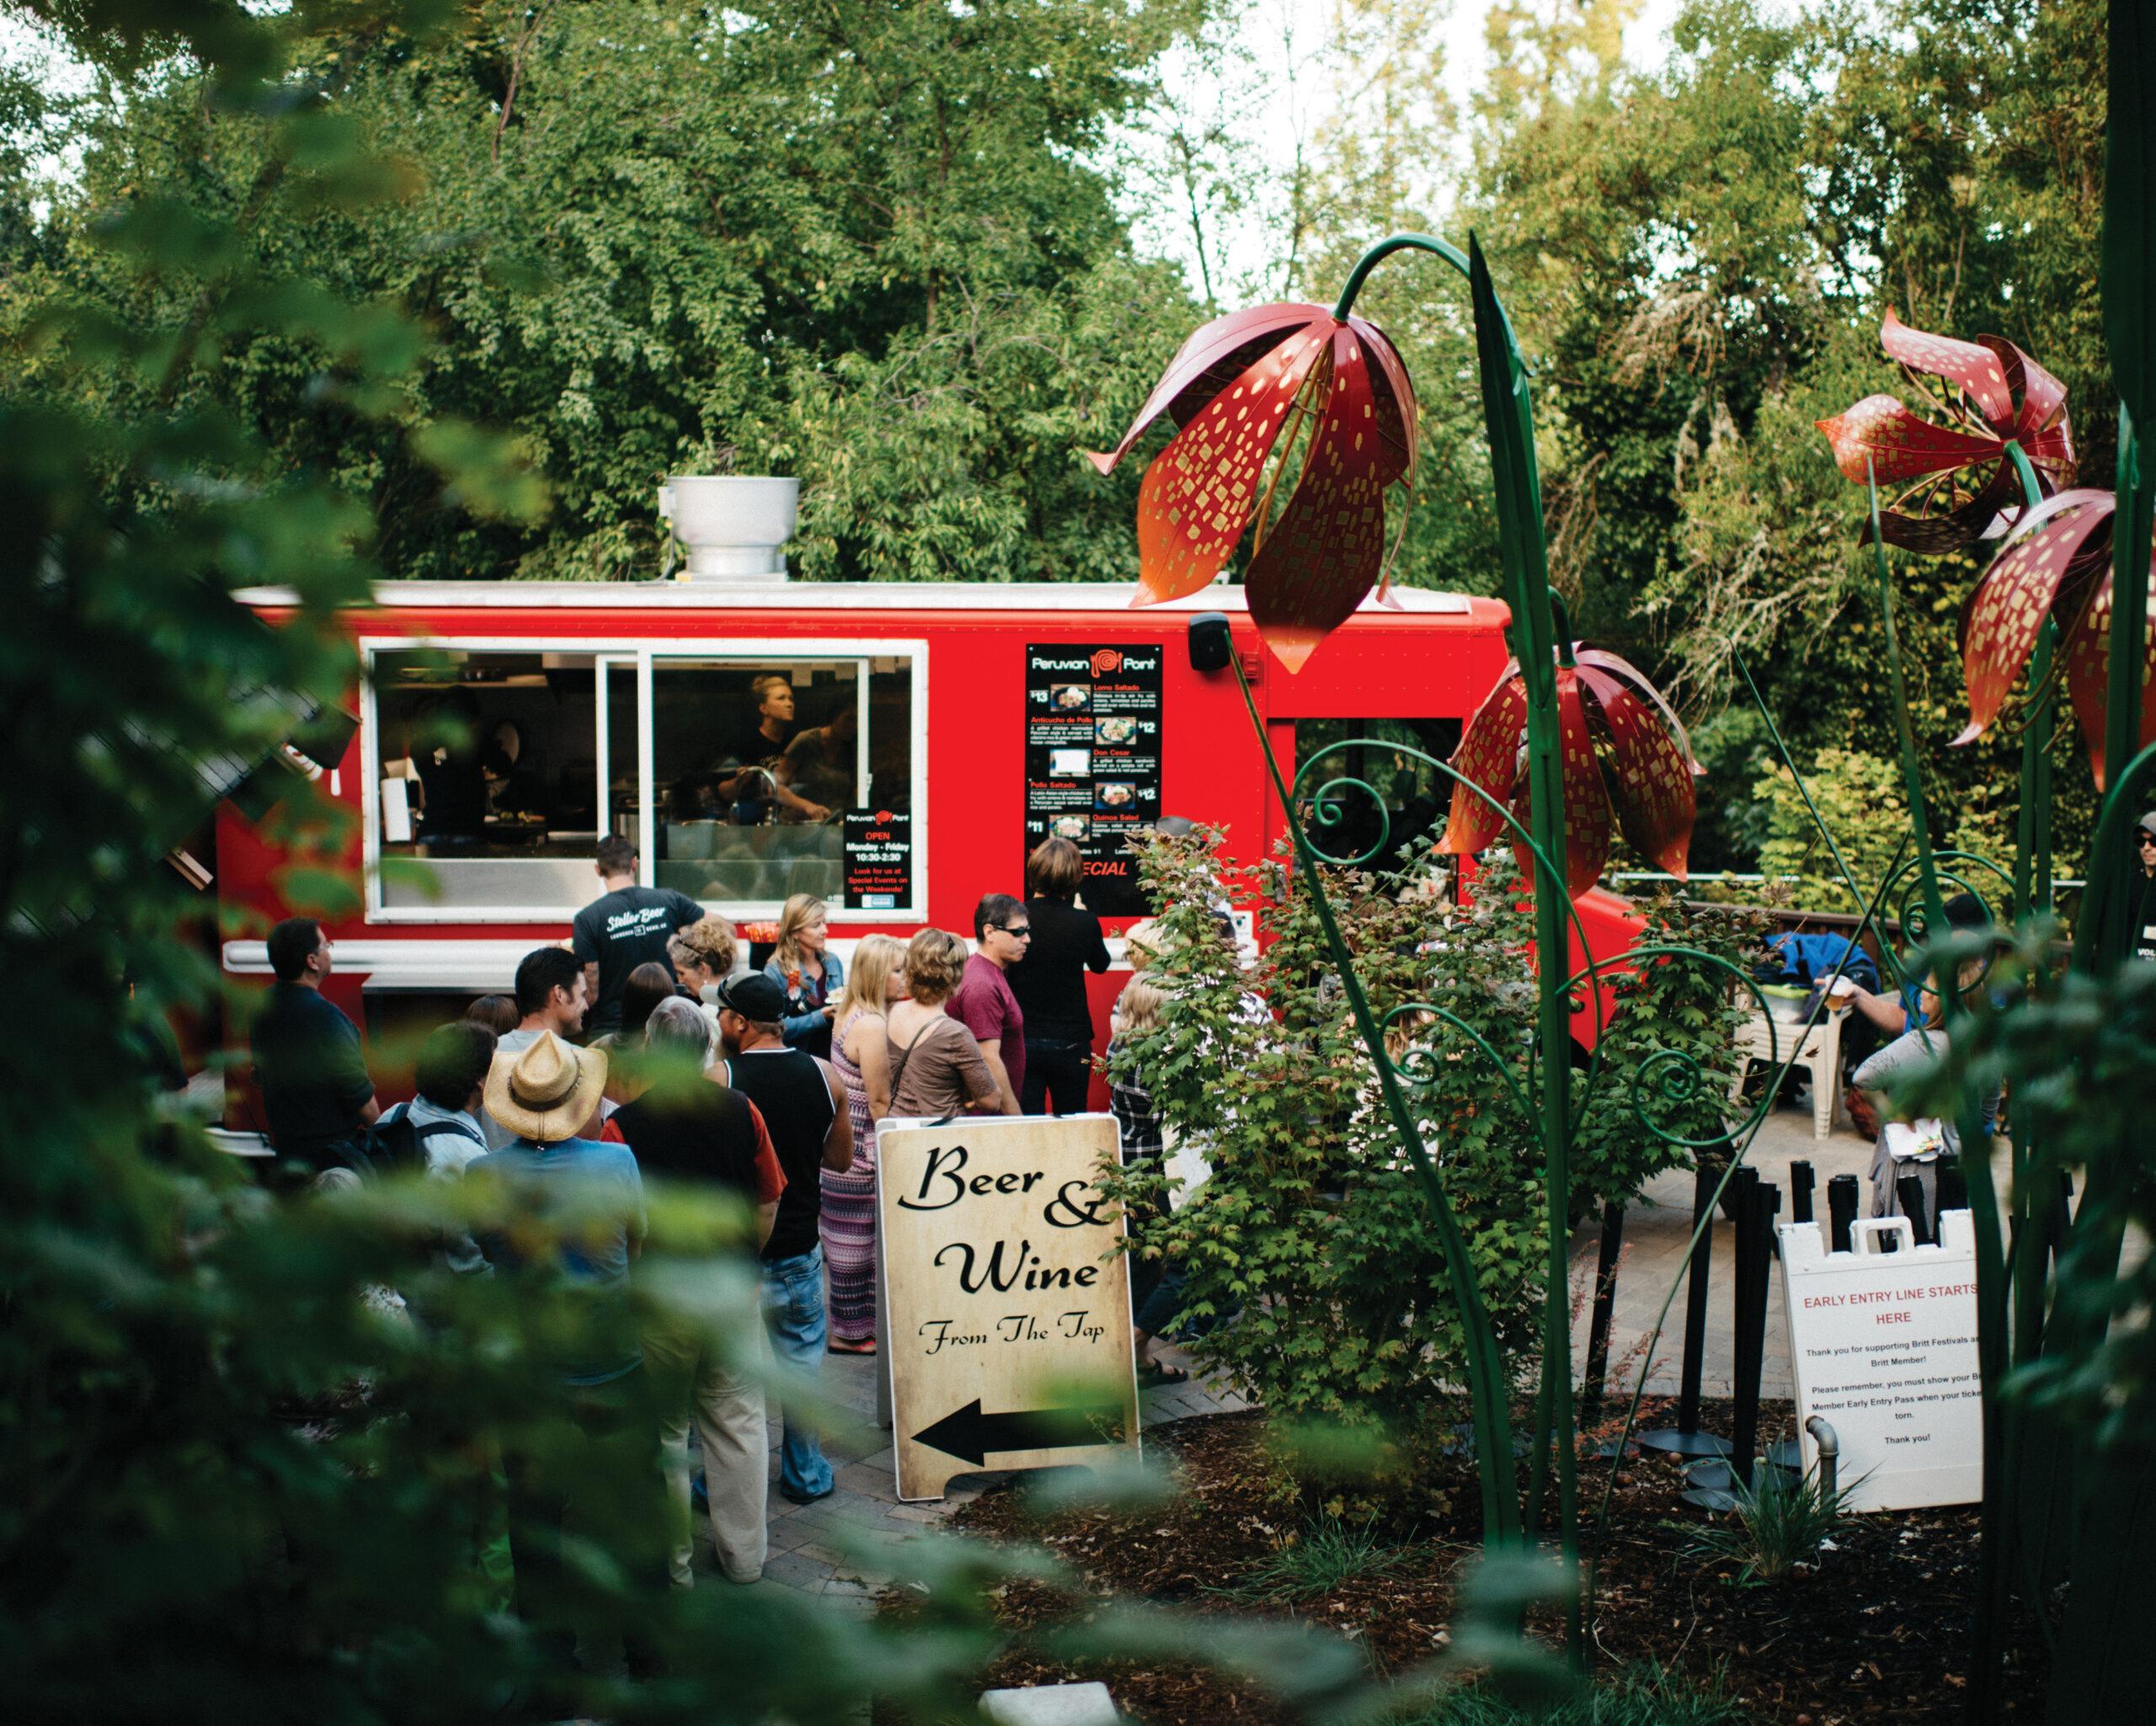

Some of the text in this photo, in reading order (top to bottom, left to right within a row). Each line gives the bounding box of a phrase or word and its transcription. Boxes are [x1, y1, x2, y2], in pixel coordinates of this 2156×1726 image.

[1032, 658, 1155, 669] Peruvian Point
[1030, 692, 1049, 703] $13
[1139, 721, 1155, 733] $12
[1139, 789, 1156, 800] $12
[1027, 821, 1043, 833] $11
[866, 832, 890, 840] OPEN
[846, 843, 878, 852] Monday
[885, 843, 909, 852] Friday
[856, 853, 900, 861] 10:30-2:30
[1083, 861, 1128, 876] ECIAL
[639, 908, 665, 923] Beer
[897, 1145, 1109, 1228] Beer &
[934, 1239, 1100, 1294] Wine
[1804, 1284, 1978, 1308] EARLY ENTRY LINE STARTS
[1876, 1312, 1912, 1324] HERE
[919, 1311, 1104, 1355] From The Tap
[1865, 1342, 1910, 1352] supporting
[1931, 1336, 1968, 1346] Festivals
[1891, 1356, 1926, 1366] Member!
[1812, 1386, 1839, 1394] Please
[1841, 1382, 1886, 1392] remember,
[1886, 1381, 1903, 1390] you
[1904, 1377, 1925, 1387] must
[1927, 1375, 1949, 1384] show
[1951, 1375, 1970, 1383] your
[1812, 1402, 1844, 1411] Member
[1847, 1399, 1868, 1409] Early
[1870, 1398, 1892, 1406] Entry
[1917, 1393, 1939, 1402] when
[1941, 1392, 1960, 1400] your
[1885, 1434, 1930, 1444] Thank you!
